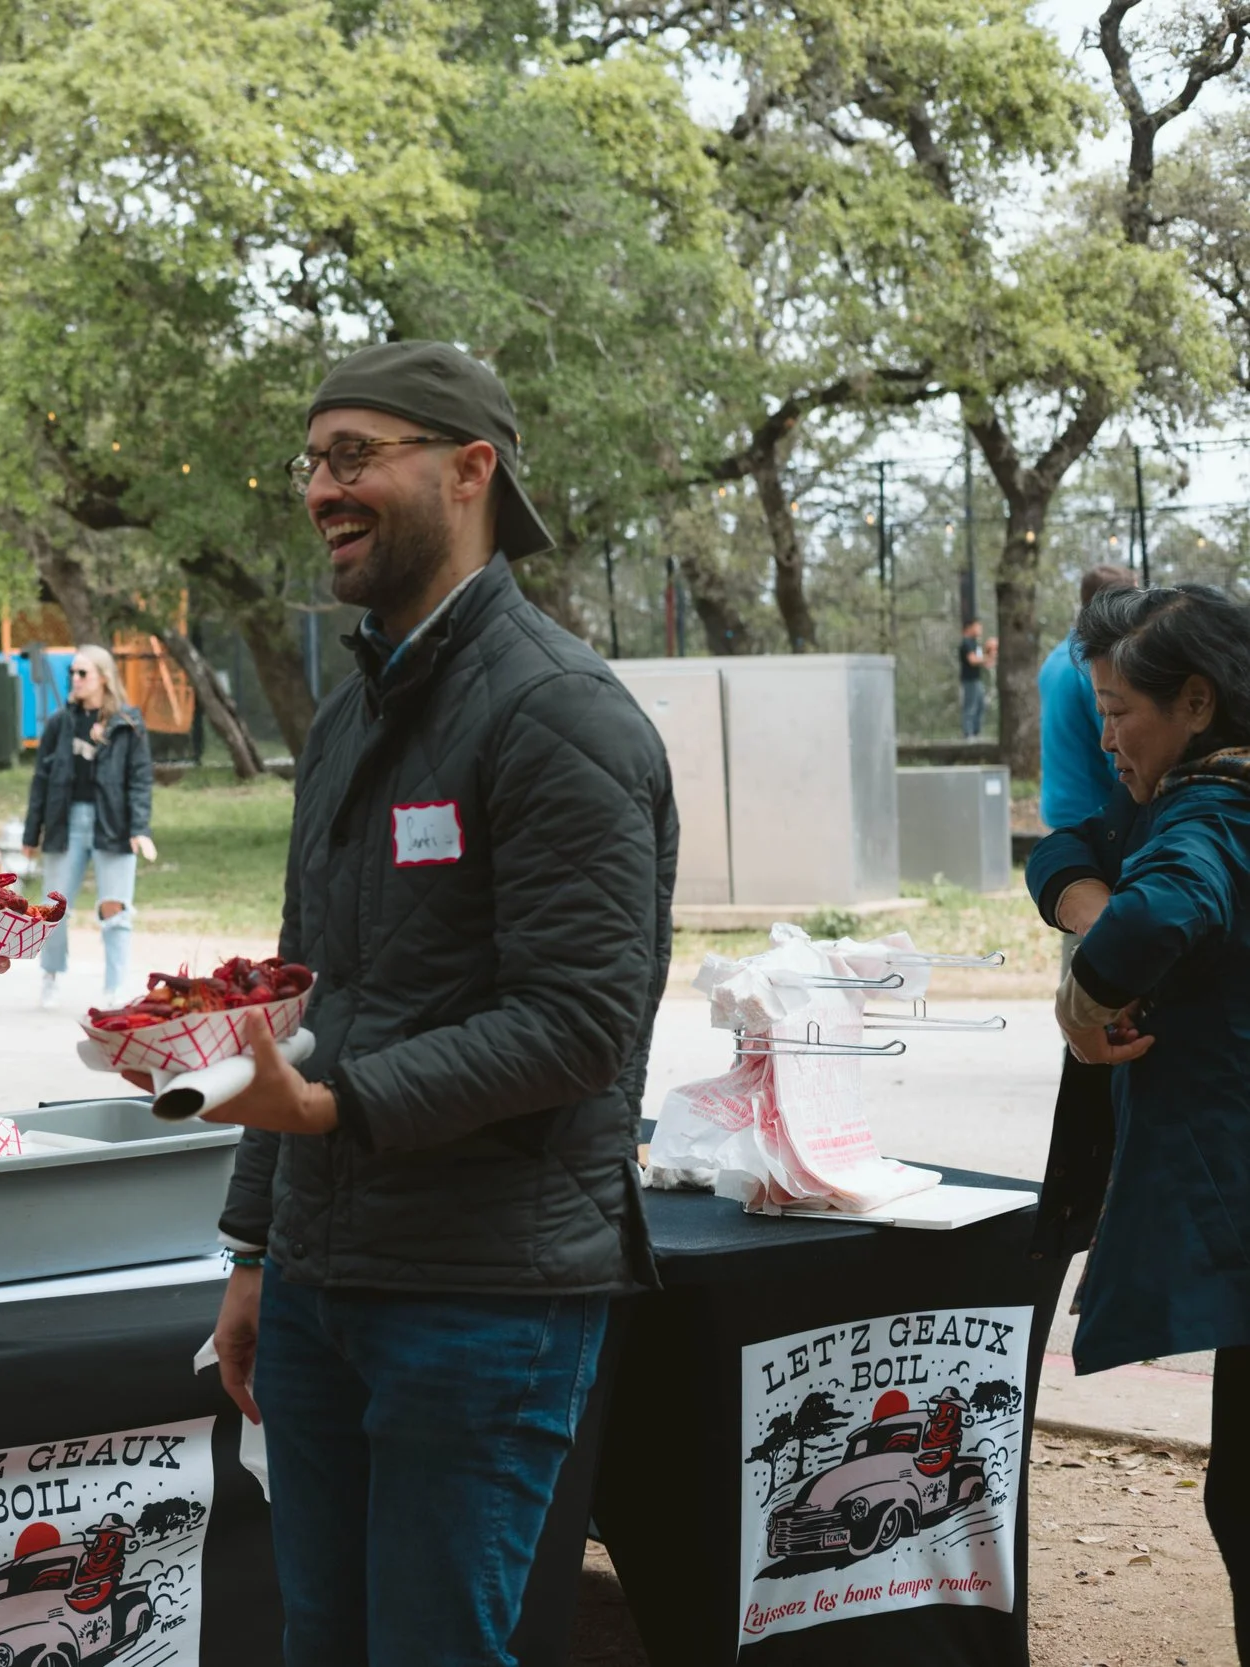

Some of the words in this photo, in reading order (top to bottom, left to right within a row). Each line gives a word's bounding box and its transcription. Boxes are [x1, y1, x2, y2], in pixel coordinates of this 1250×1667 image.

[762, 1324, 871, 1395] LET'Z
[889, 1315, 1013, 1356] GEAUX
[850, 1354, 928, 1393] BOIL
[27, 1436, 186, 1473] GEAUX
[921, 1482, 934, 1498] WHO
[743, 1601, 807, 1635] Laissez
[813, 1588, 839, 1611] les
[843, 1583, 883, 1604] bons
[888, 1577, 934, 1600] temps
[938, 1571, 993, 1593] rouler
[78, 1620, 93, 1640] WHO
[97, 1615, 111, 1630] DAT
